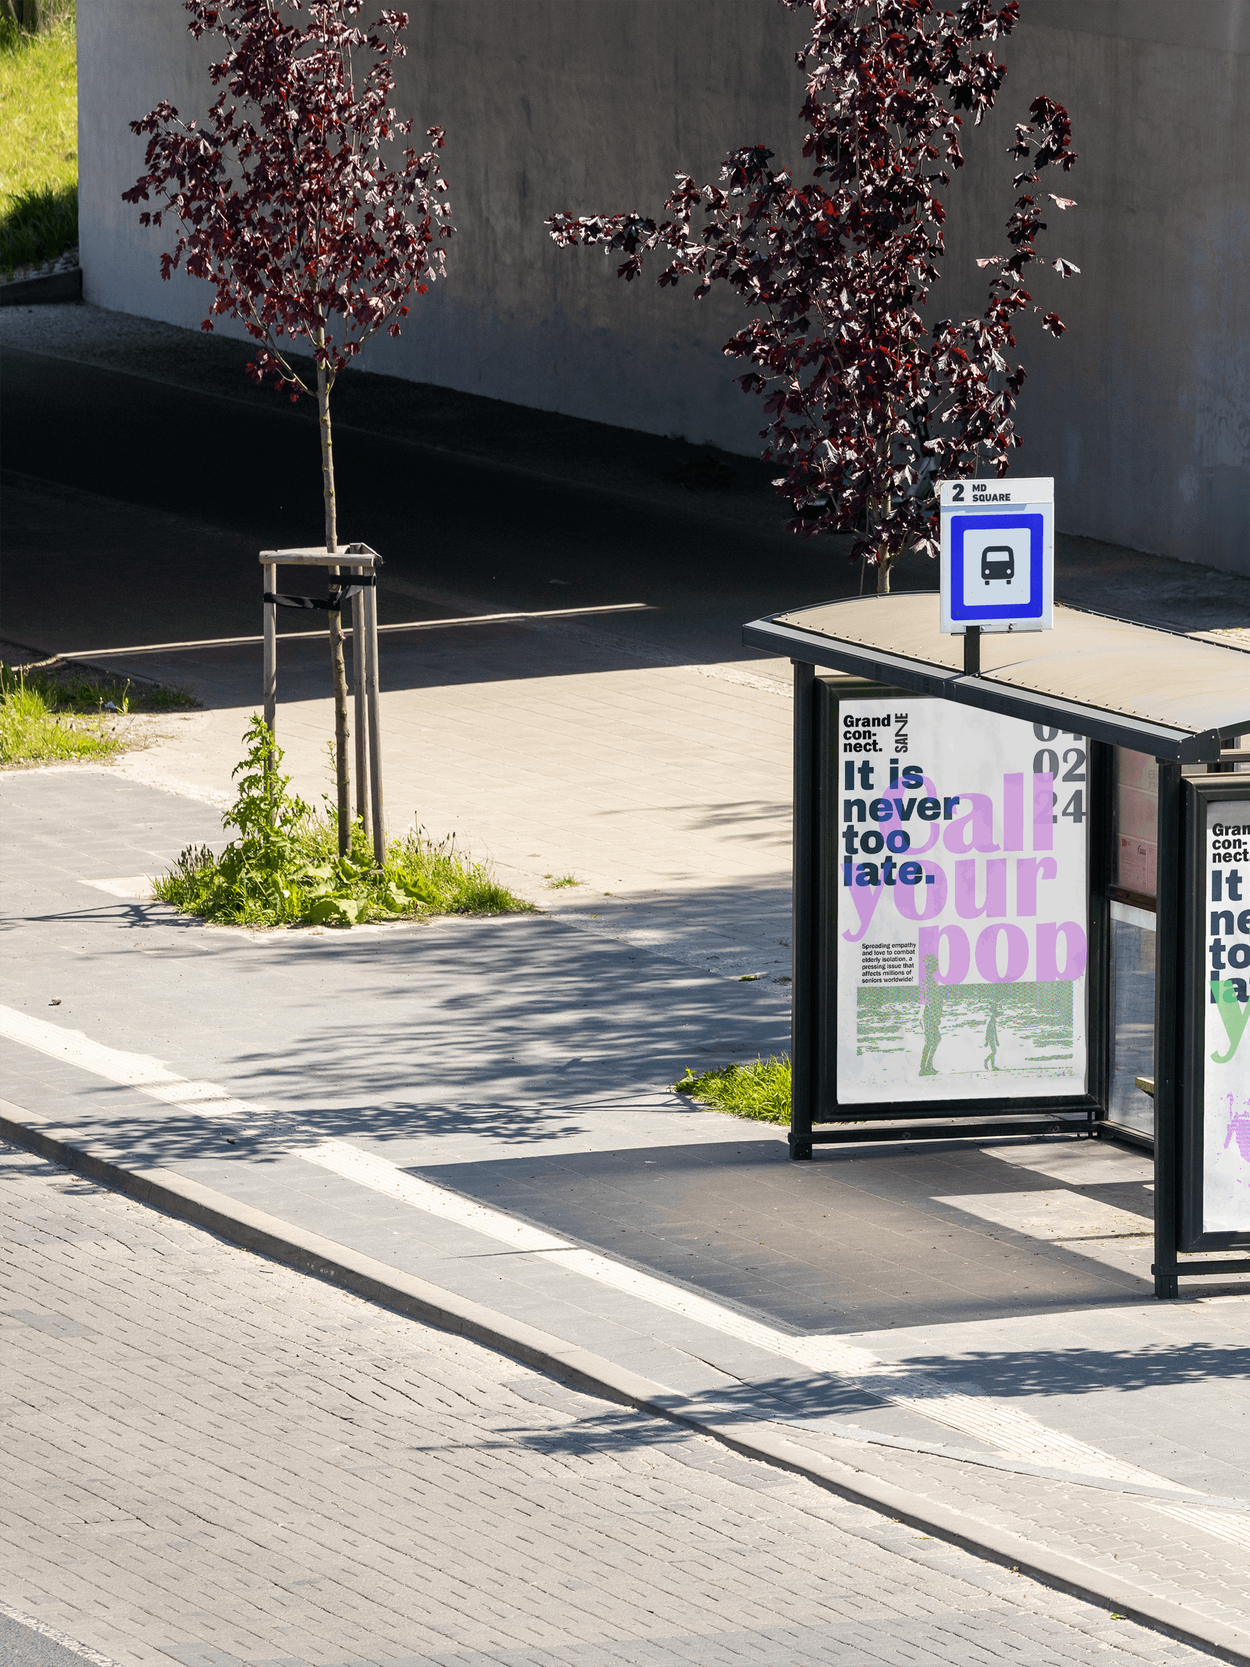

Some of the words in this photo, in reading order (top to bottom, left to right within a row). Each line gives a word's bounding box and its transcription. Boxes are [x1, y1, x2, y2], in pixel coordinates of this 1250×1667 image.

[952, 483, 964, 502] 2
[972, 484, 987, 492] MD
[972, 493, 1011, 502] SQUARE
[843, 714, 891, 727] Grand
[843, 729, 876, 740] con-
[844, 740, 882, 753] nect.
[845, 760, 874, 790] It
[890, 758, 923, 789] is
[1033, 748, 1086, 783] 02
[844, 796, 959, 822] never
[878, 772, 1053, 855] Call
[1033, 789, 1086, 824] 24
[842, 825, 910, 855] too
[1212, 838, 1247, 850] con-
[844, 855, 935, 886] late.
[1211, 869, 1242, 902] It
[840, 856, 1057, 942] your
[918, 921, 1087, 1004] pop
